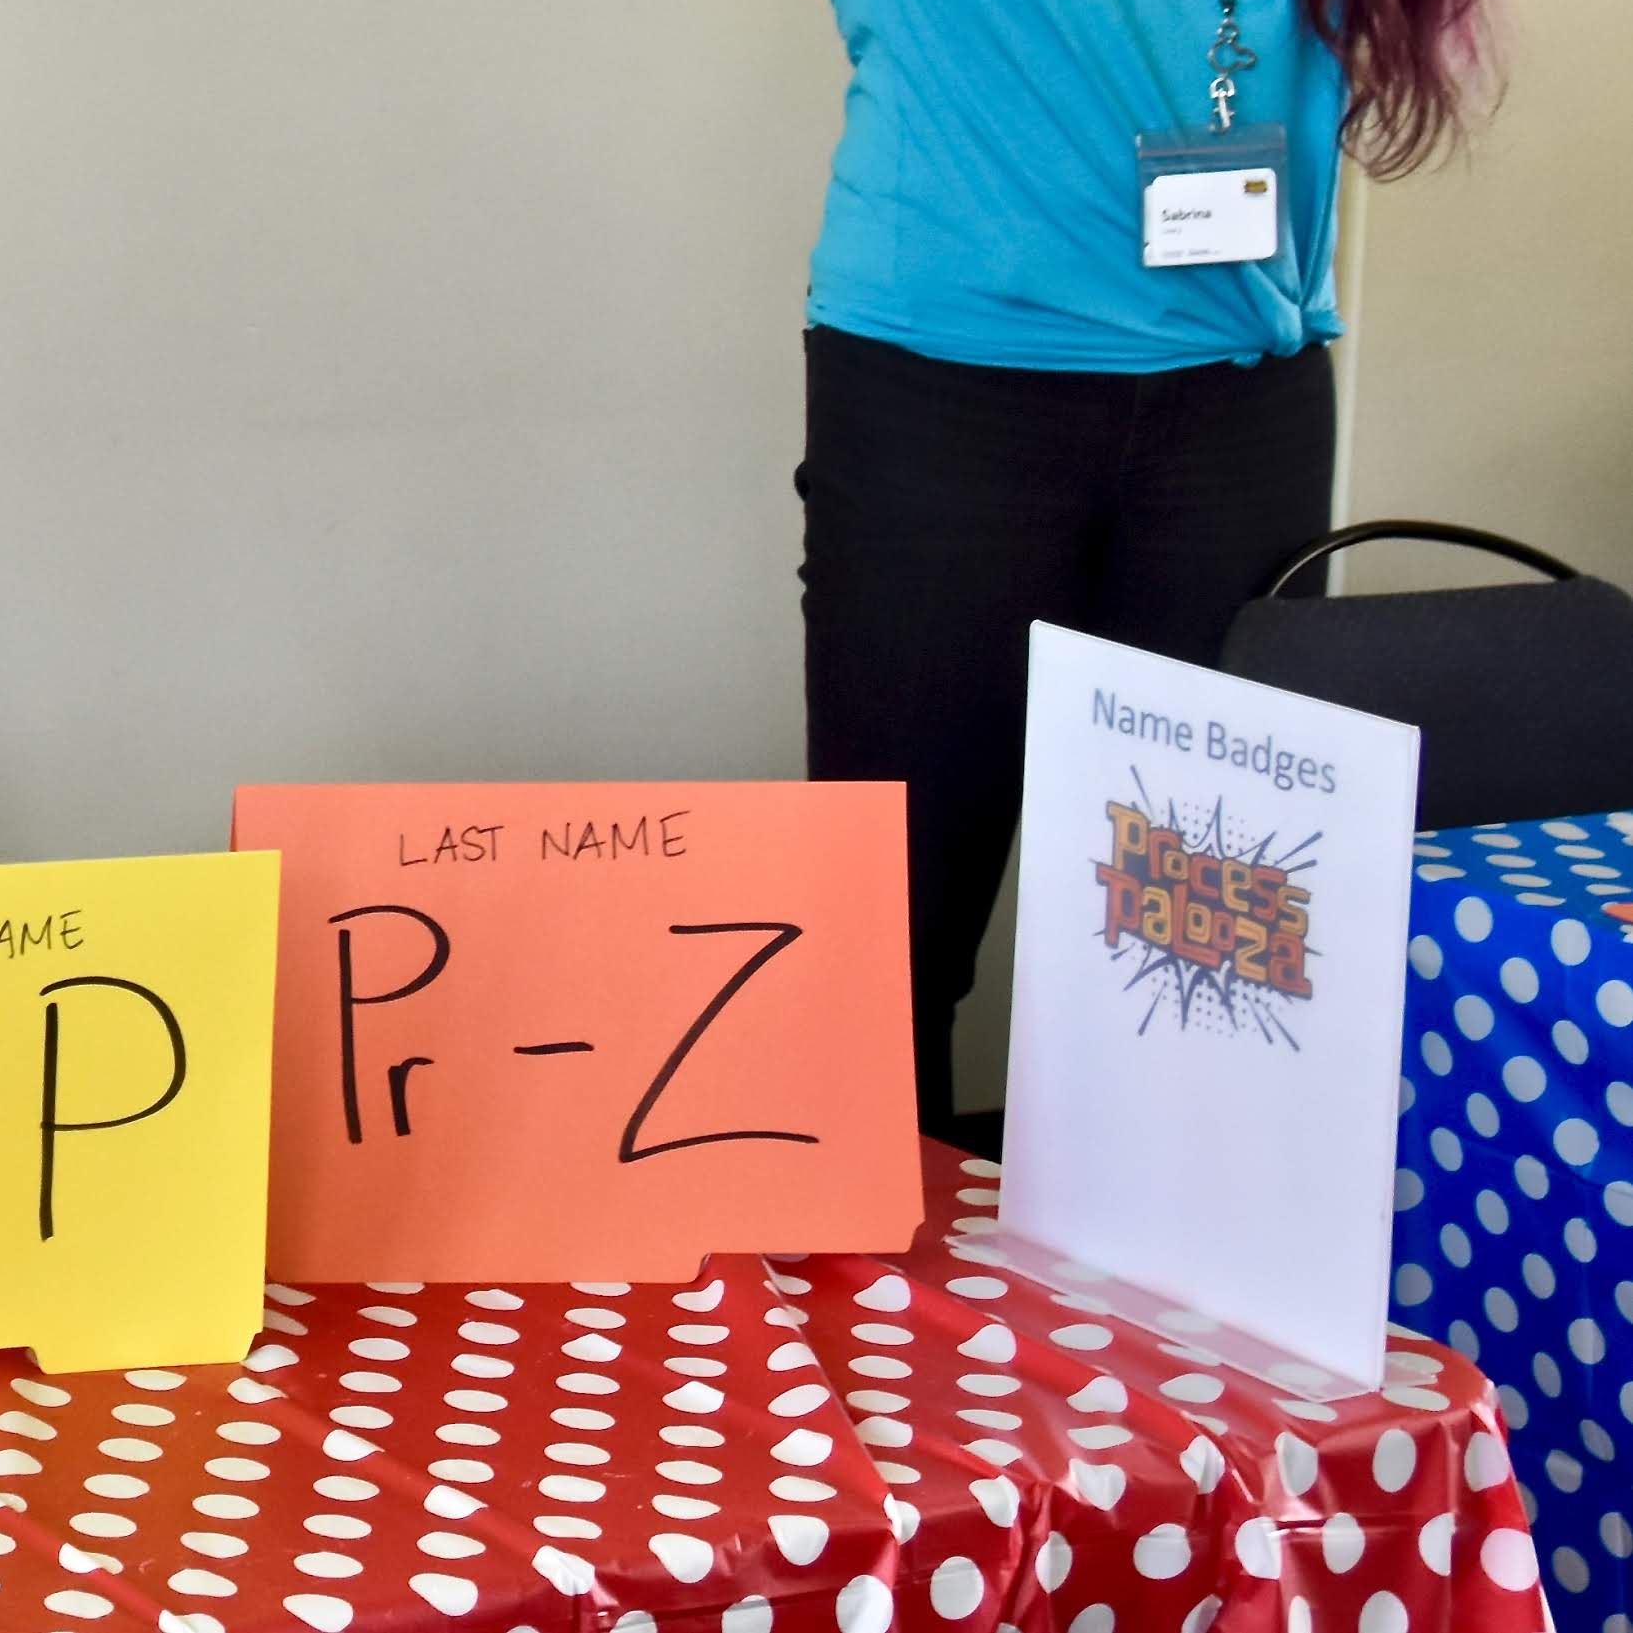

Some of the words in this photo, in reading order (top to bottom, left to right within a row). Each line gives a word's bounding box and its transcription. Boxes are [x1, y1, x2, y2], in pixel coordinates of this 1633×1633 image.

[1092, 688, 1194, 753] Name
[1207, 721, 1337, 794] Badges
[397, 824, 504, 867] LAST
[539, 810, 695, 862] NAME
[1105, 800, 1312, 937] Process
